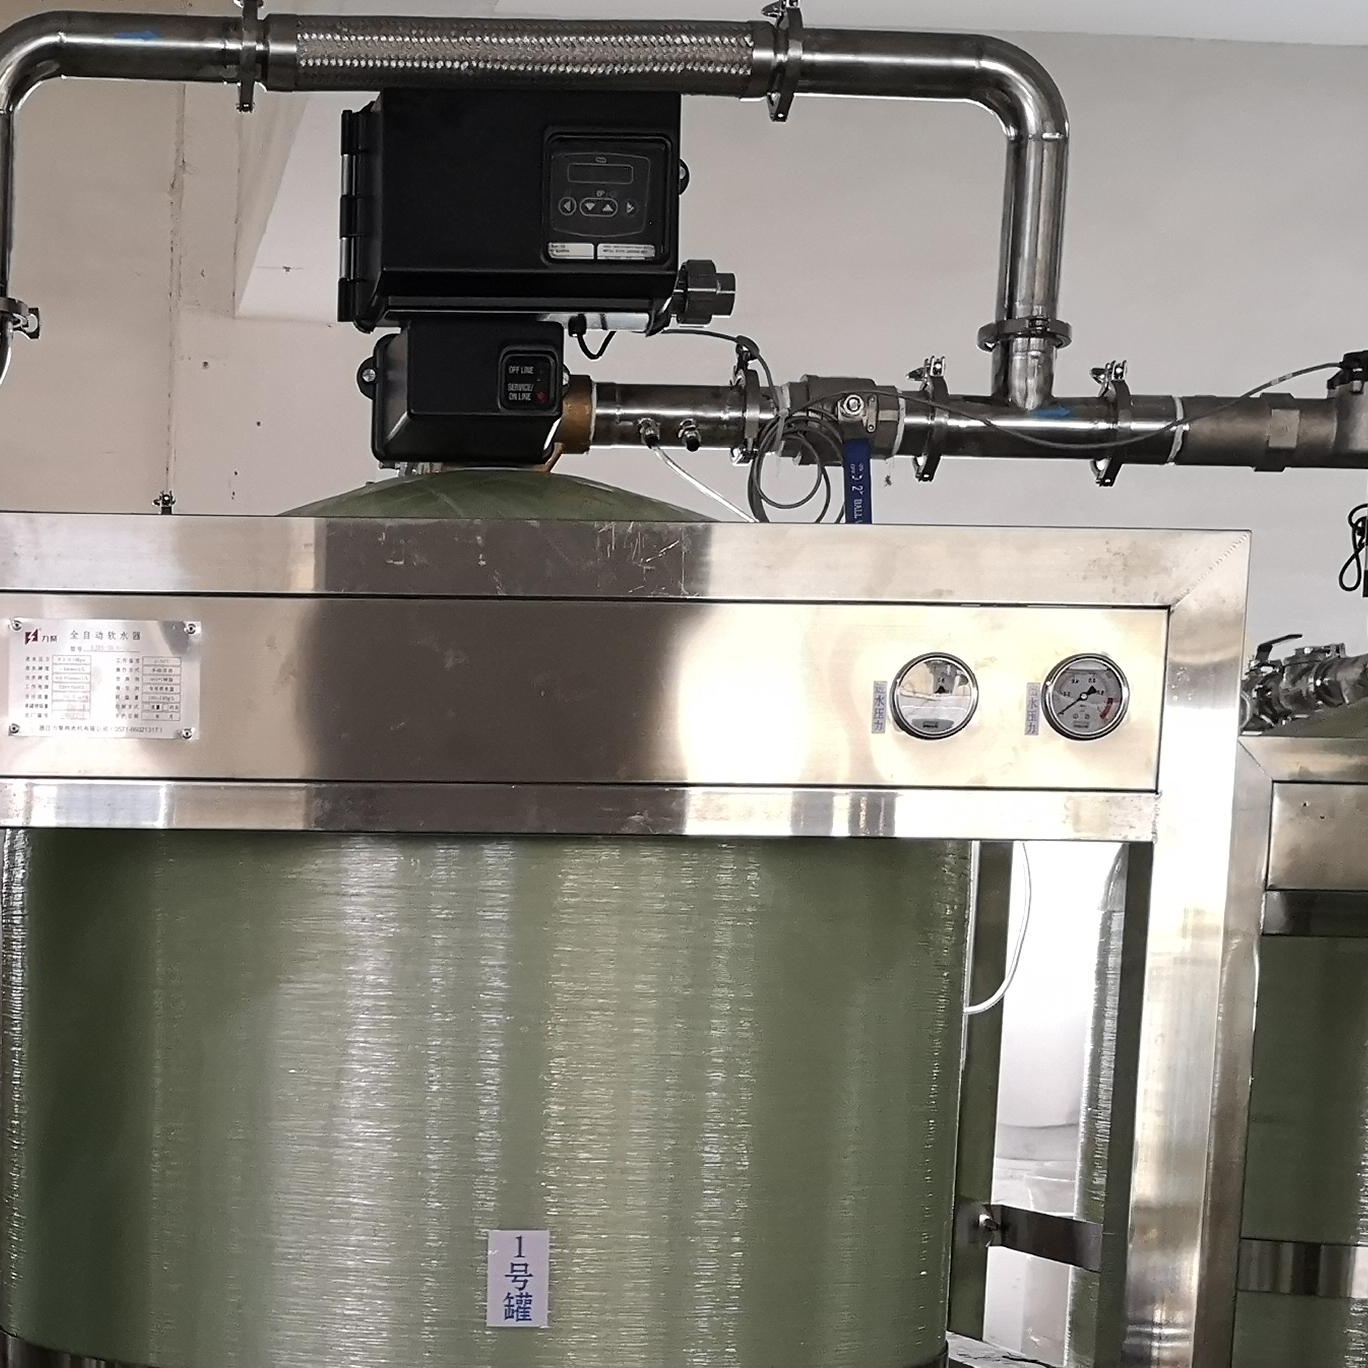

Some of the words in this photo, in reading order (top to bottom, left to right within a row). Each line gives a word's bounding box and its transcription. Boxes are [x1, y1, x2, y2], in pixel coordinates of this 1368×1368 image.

[70, 630, 141, 641] 全自动软水器
[503, 1235, 533, 1322] 1号罐
